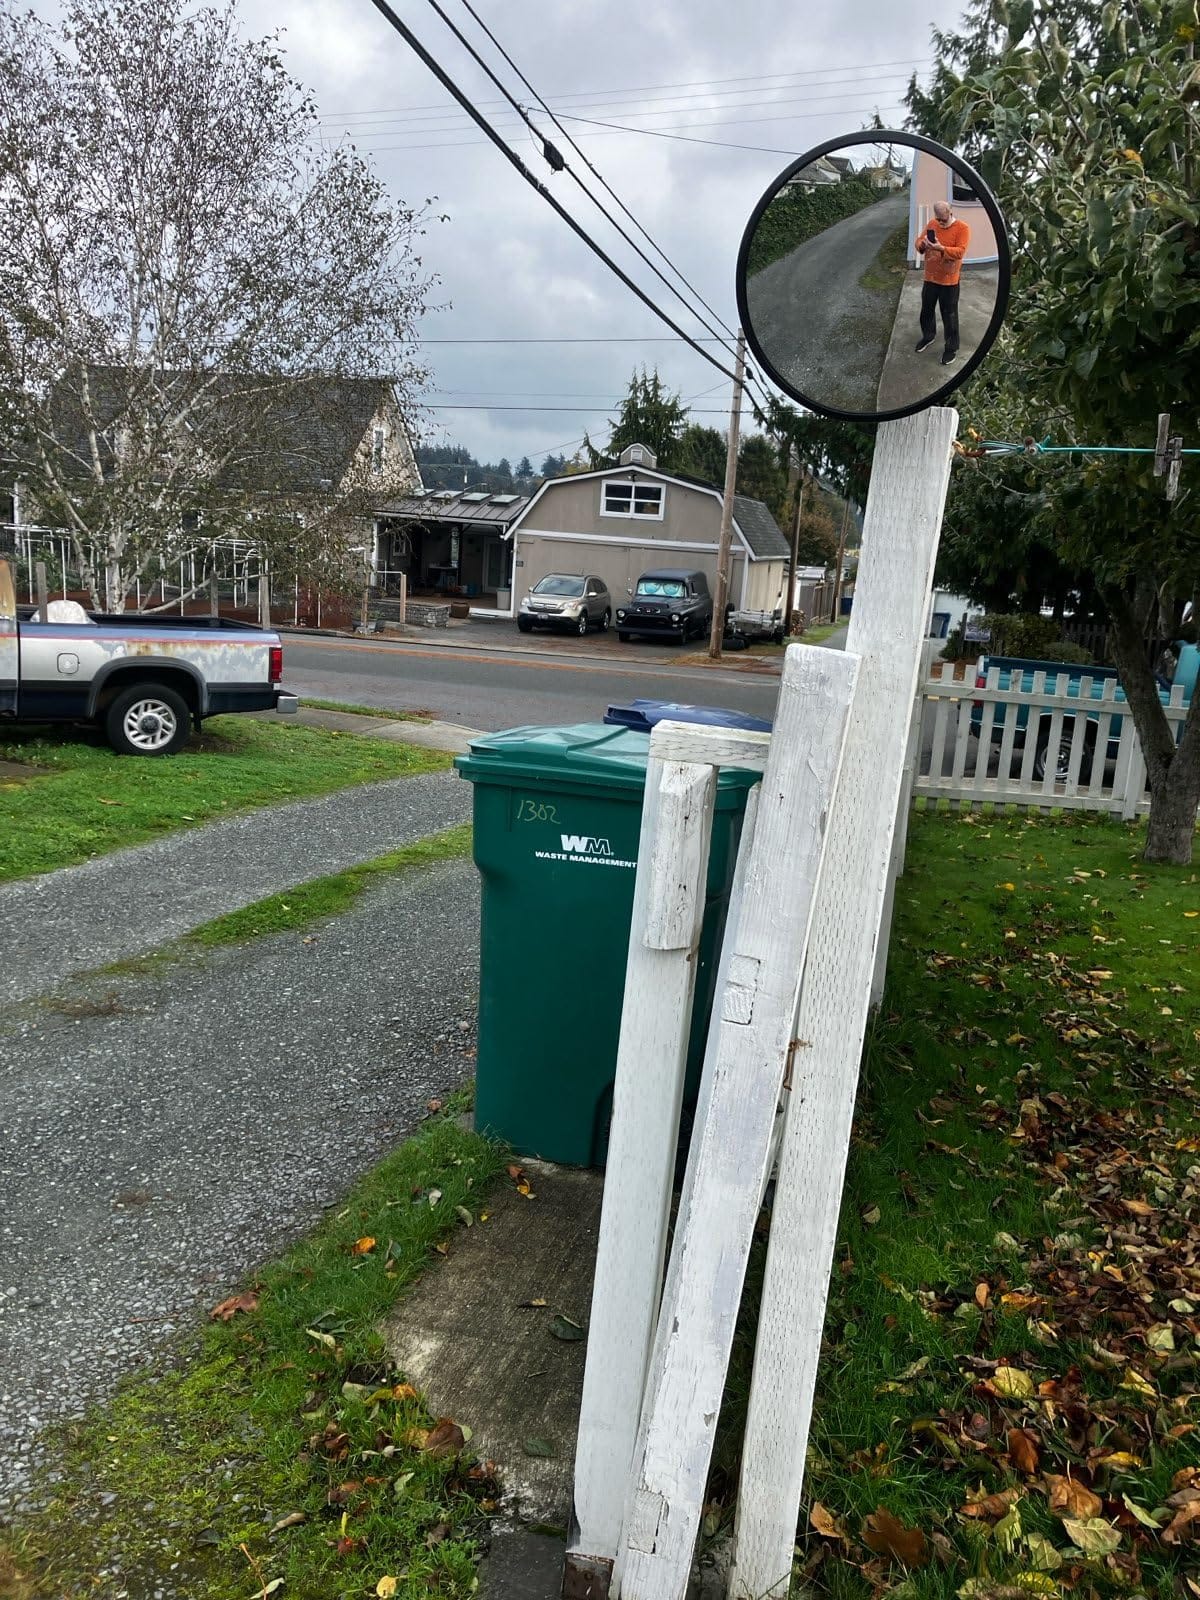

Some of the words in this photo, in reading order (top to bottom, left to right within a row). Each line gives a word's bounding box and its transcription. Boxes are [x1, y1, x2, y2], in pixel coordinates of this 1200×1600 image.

[517, 800, 561, 824] 1302
[560, 834, 611, 855] WM
[535, 851, 567, 861] WASTE
[569, 854, 637, 868] MANAGEMENT
